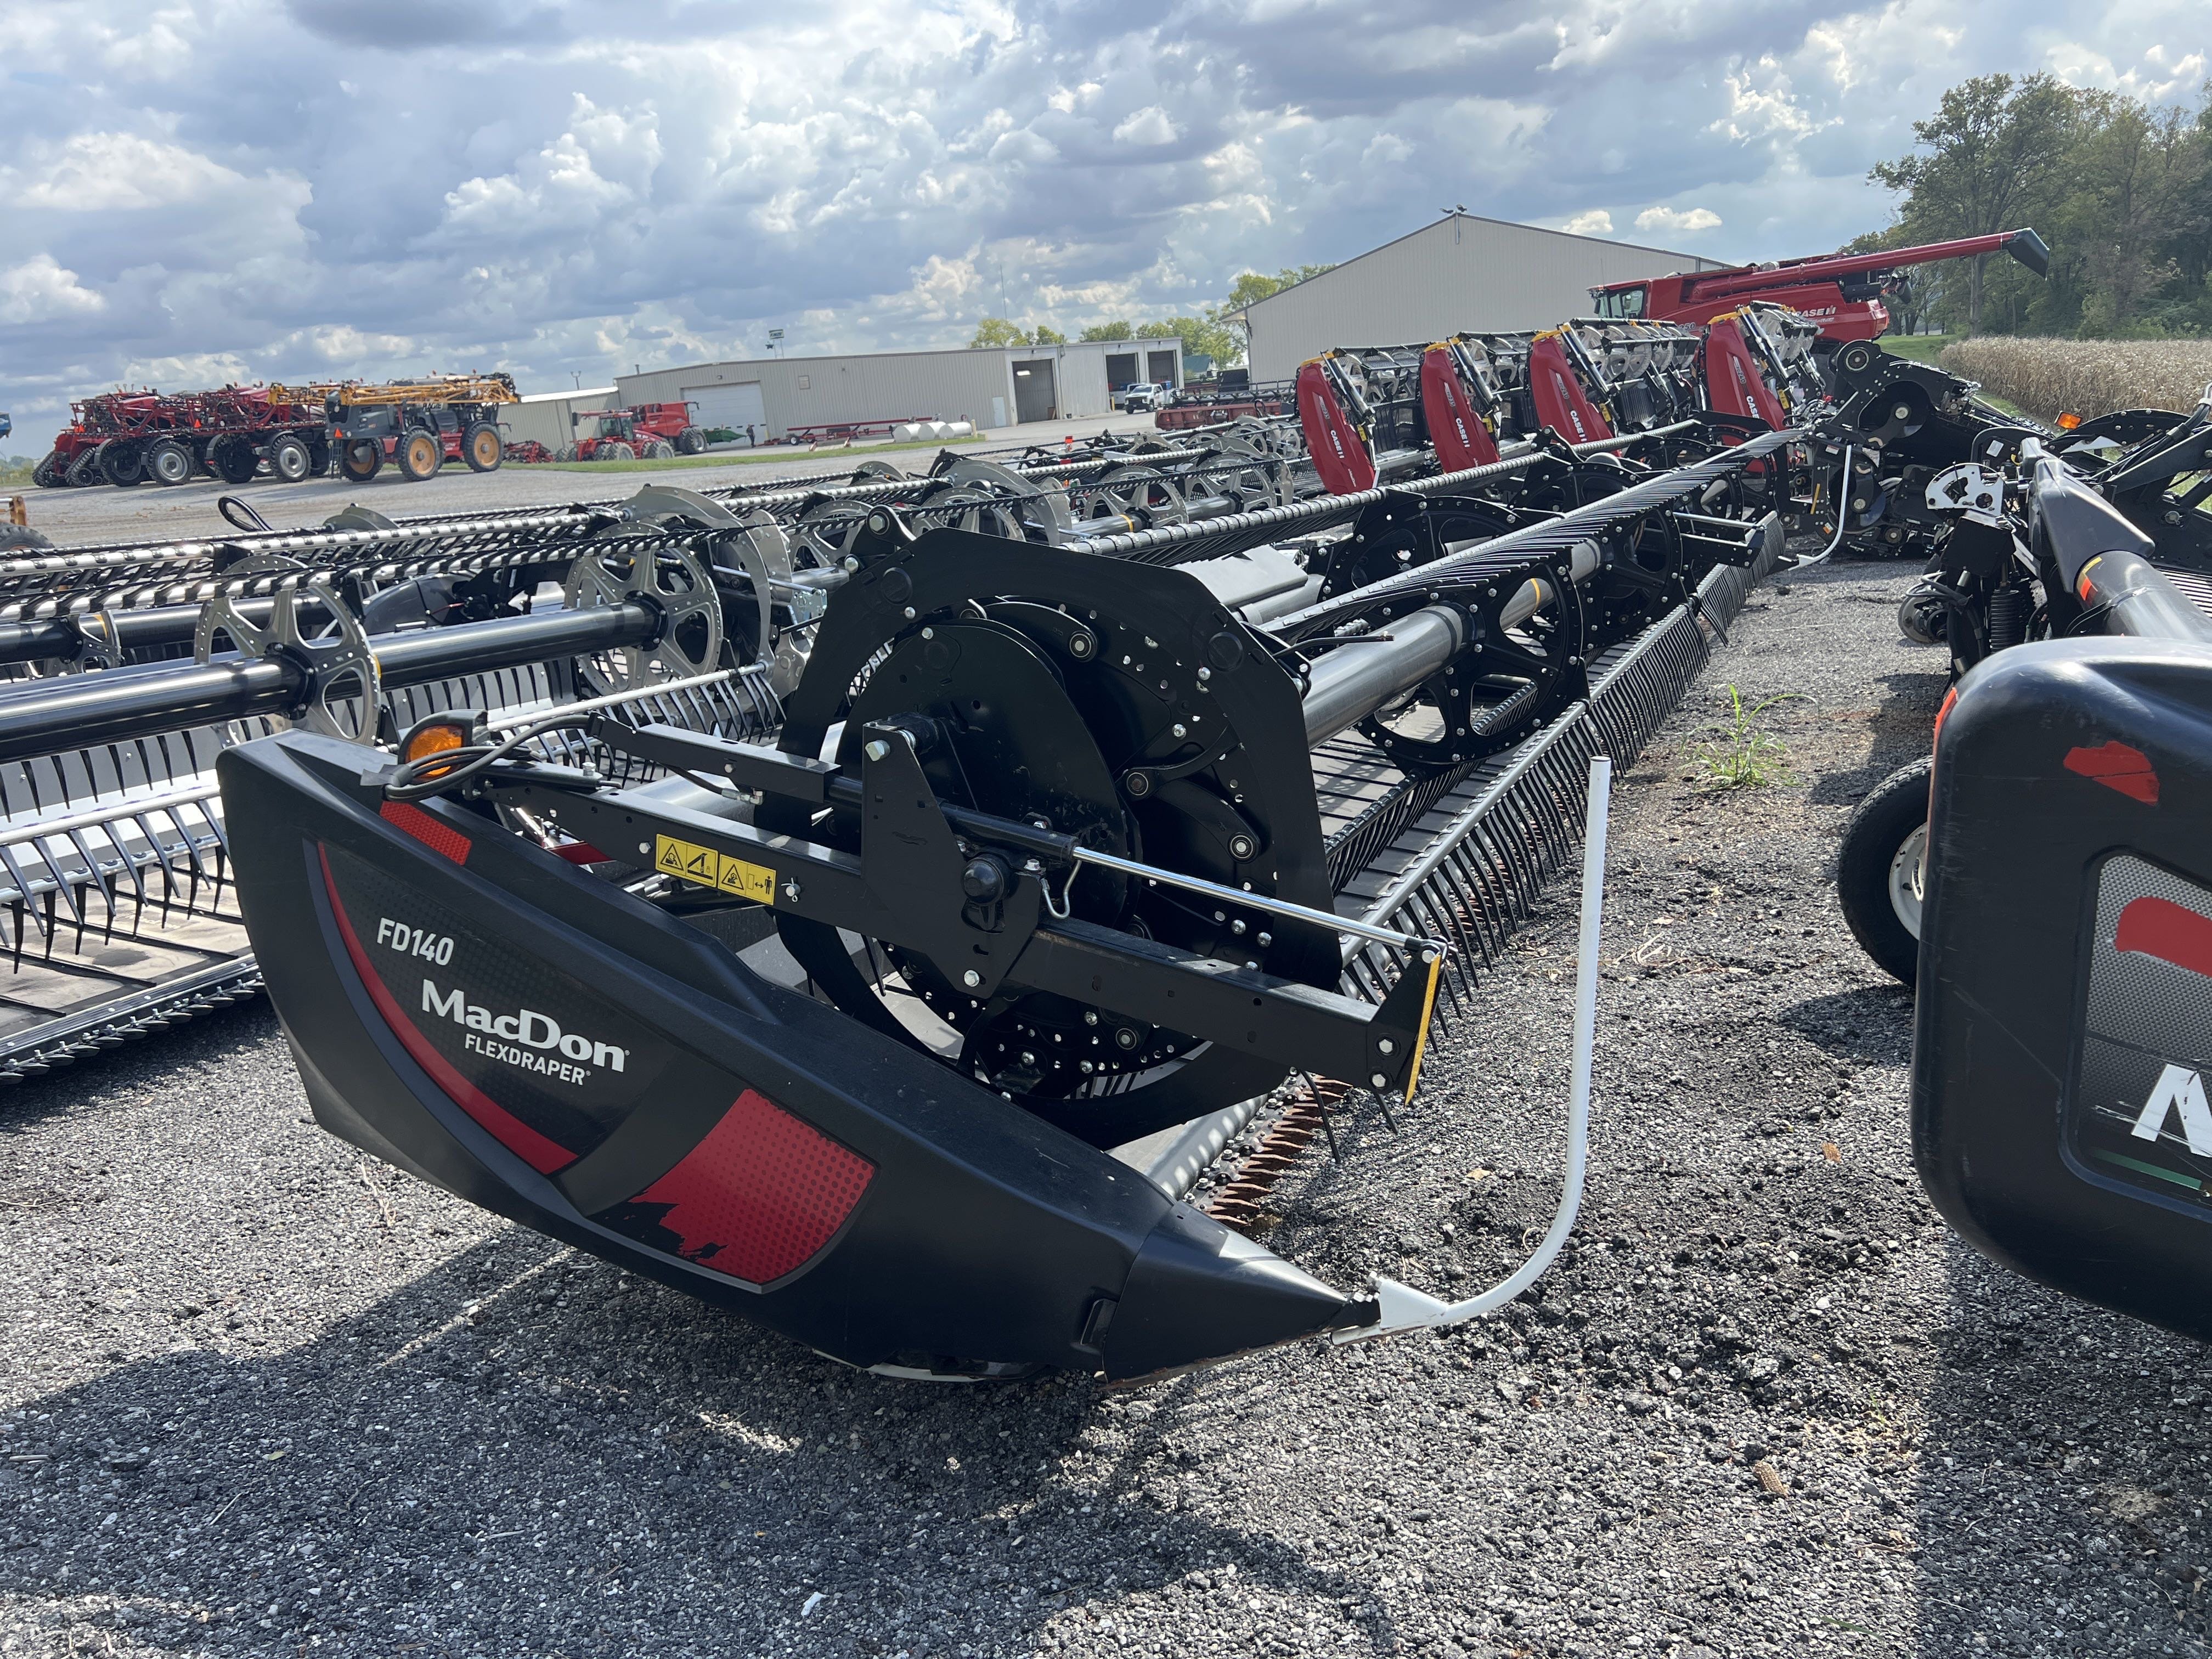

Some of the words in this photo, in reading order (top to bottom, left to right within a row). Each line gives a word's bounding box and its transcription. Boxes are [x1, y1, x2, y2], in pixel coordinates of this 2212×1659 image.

[1456, 418, 1468, 439] CASE
[1571, 410, 1584, 433] CASE
[1330, 430, 1341, 451] CASE
[376, 917, 454, 966] FD140
[421, 978, 625, 1073] MacDon
[465, 1033, 585, 1086] FLEXDRAPER
